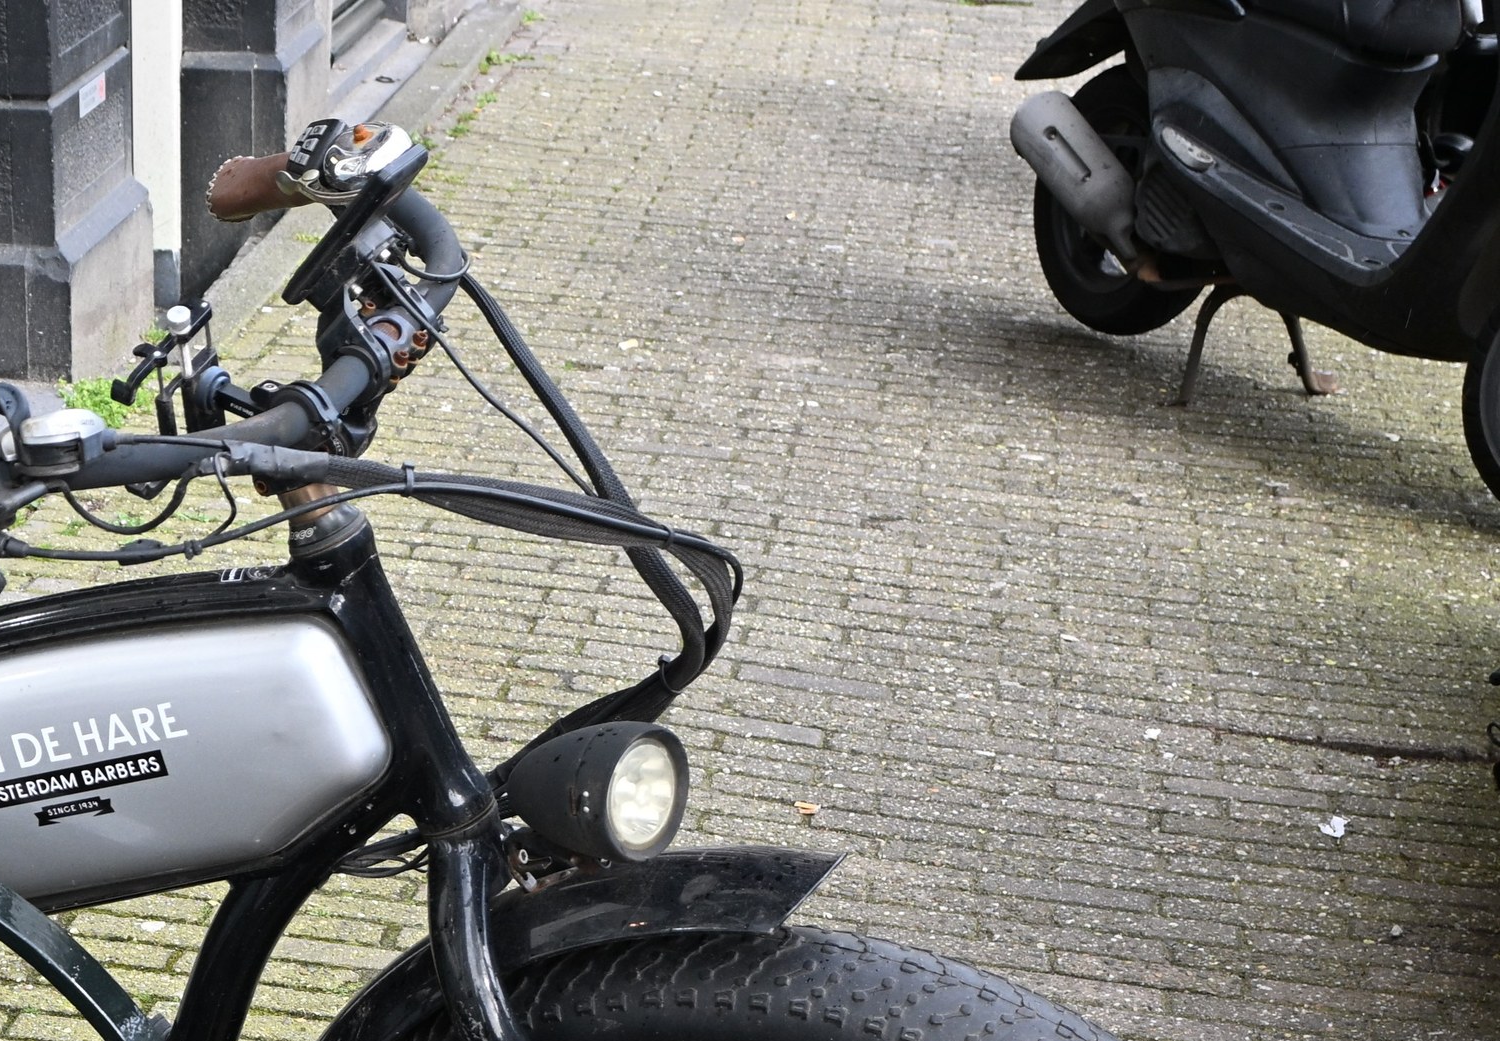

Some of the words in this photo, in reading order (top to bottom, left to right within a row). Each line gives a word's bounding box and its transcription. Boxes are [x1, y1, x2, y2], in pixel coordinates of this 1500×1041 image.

[11, 726, 71, 768] DE
[73, 702, 189, 756] HARE
[82, 756, 161, 786] BARBERS
[47, 803, 77, 817] SINCE
[78, 800, 99, 811] 1934
